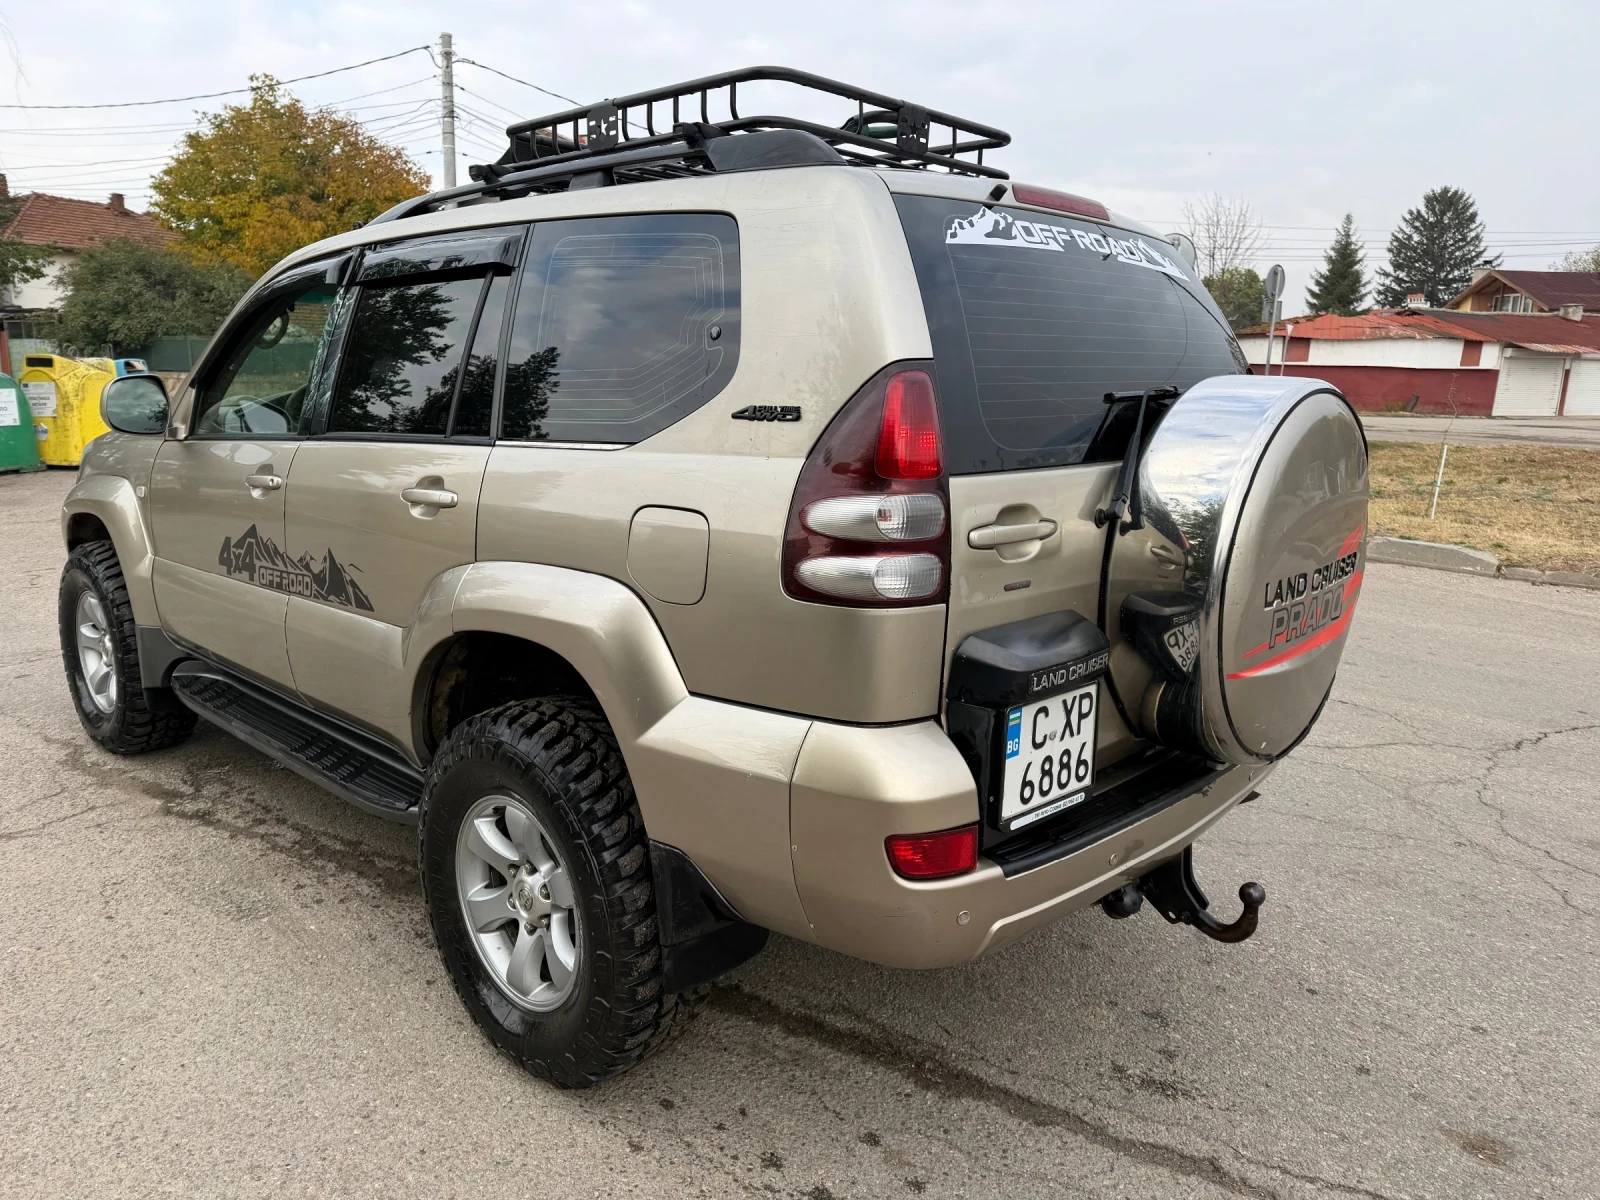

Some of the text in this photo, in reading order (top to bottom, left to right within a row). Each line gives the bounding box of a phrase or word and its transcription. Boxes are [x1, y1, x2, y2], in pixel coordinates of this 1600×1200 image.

[1013, 220, 1142, 261] OFF ROAD
[731, 405, 802, 422] 4WD
[259, 567, 312, 595] OFF ROAD
[1264, 551, 1359, 611] LAND CRUISER
[1268, 584, 1345, 649] PRADO
[1033, 652, 1109, 691] LAND CRUISER
[1006, 739, 1019, 754] BG
[1019, 741, 1090, 805] 6886
